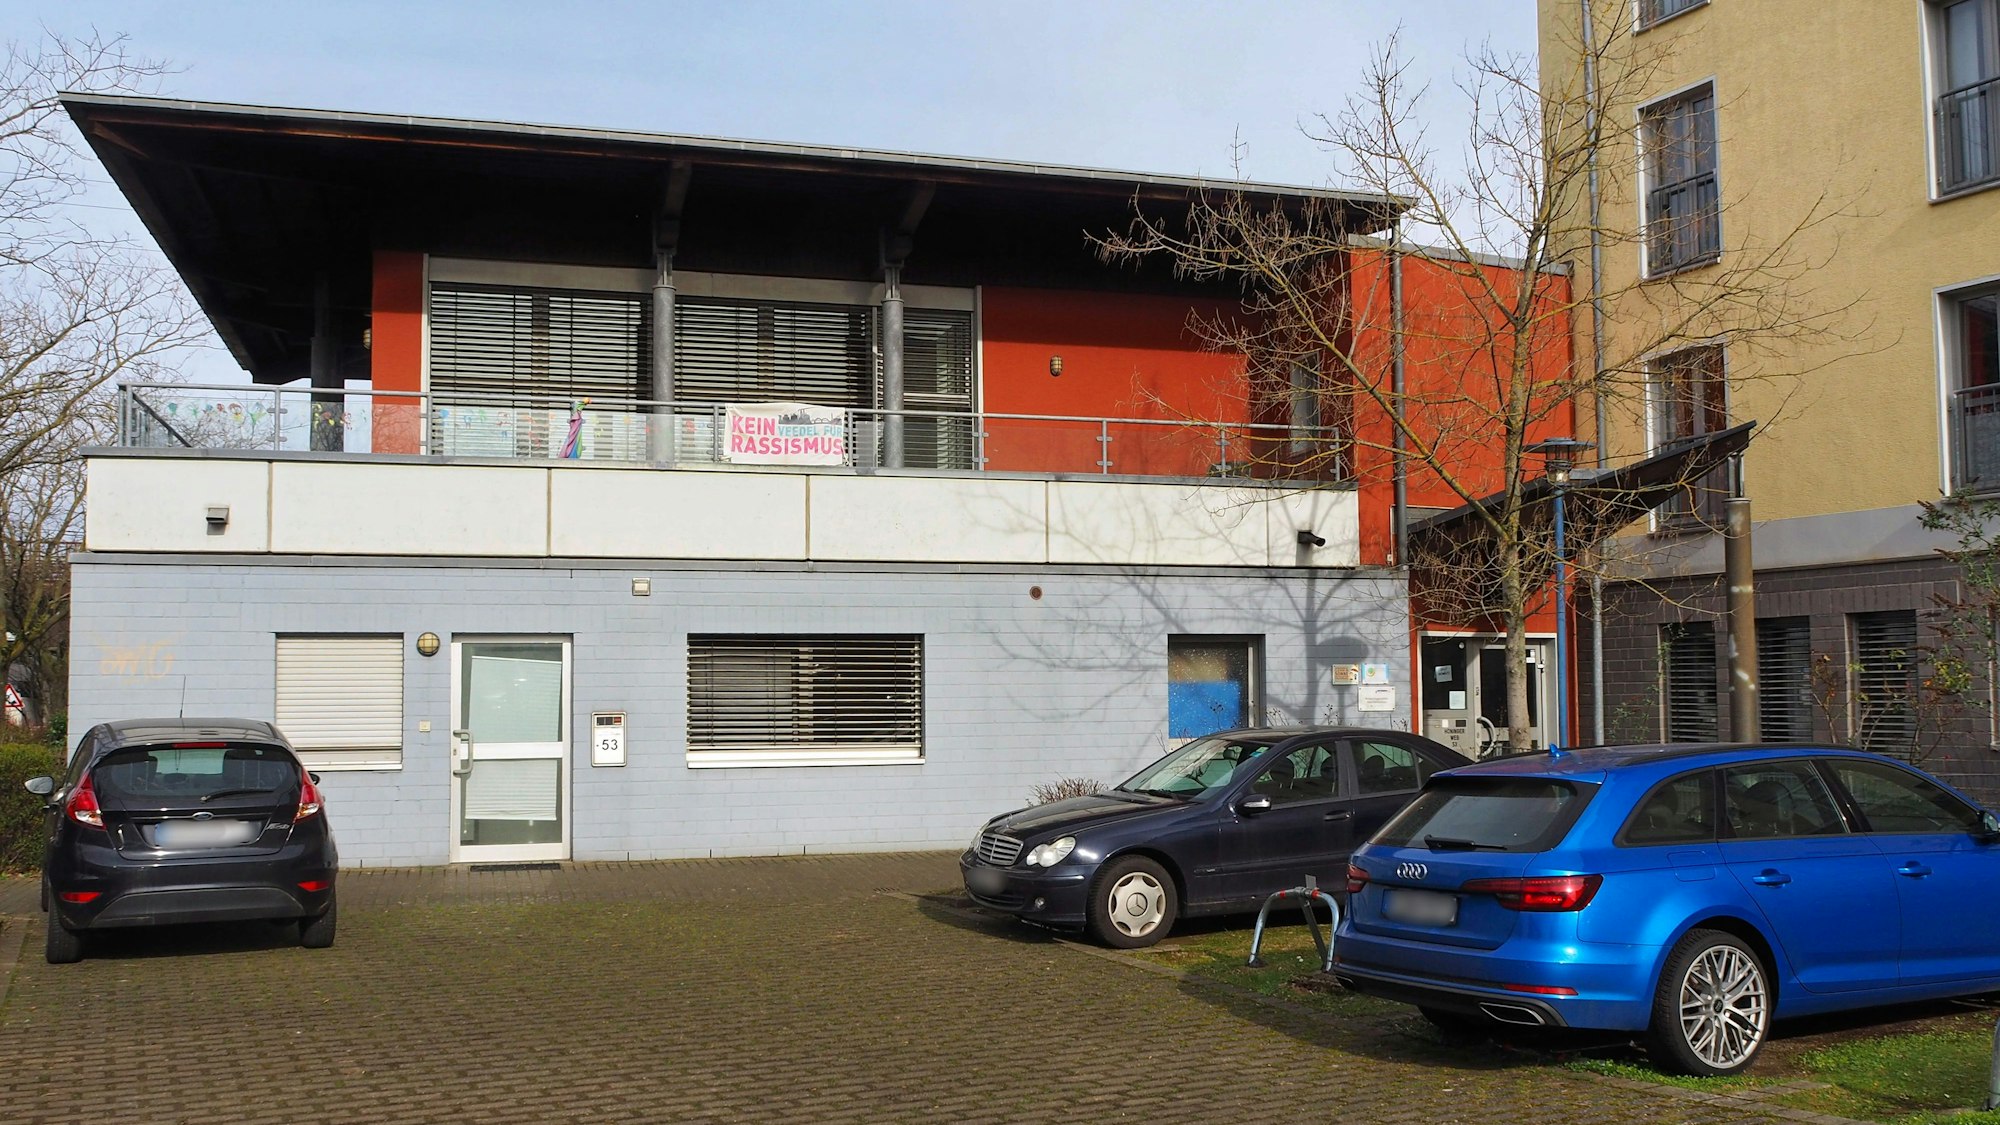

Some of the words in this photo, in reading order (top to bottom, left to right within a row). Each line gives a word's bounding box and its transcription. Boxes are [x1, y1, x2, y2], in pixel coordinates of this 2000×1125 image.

[731, 415, 775, 436] KEIN
[777, 425, 818, 438] VEEDEL
[731, 434, 843, 455] RASSISMUS
[602, 739, 618, 750] 53
